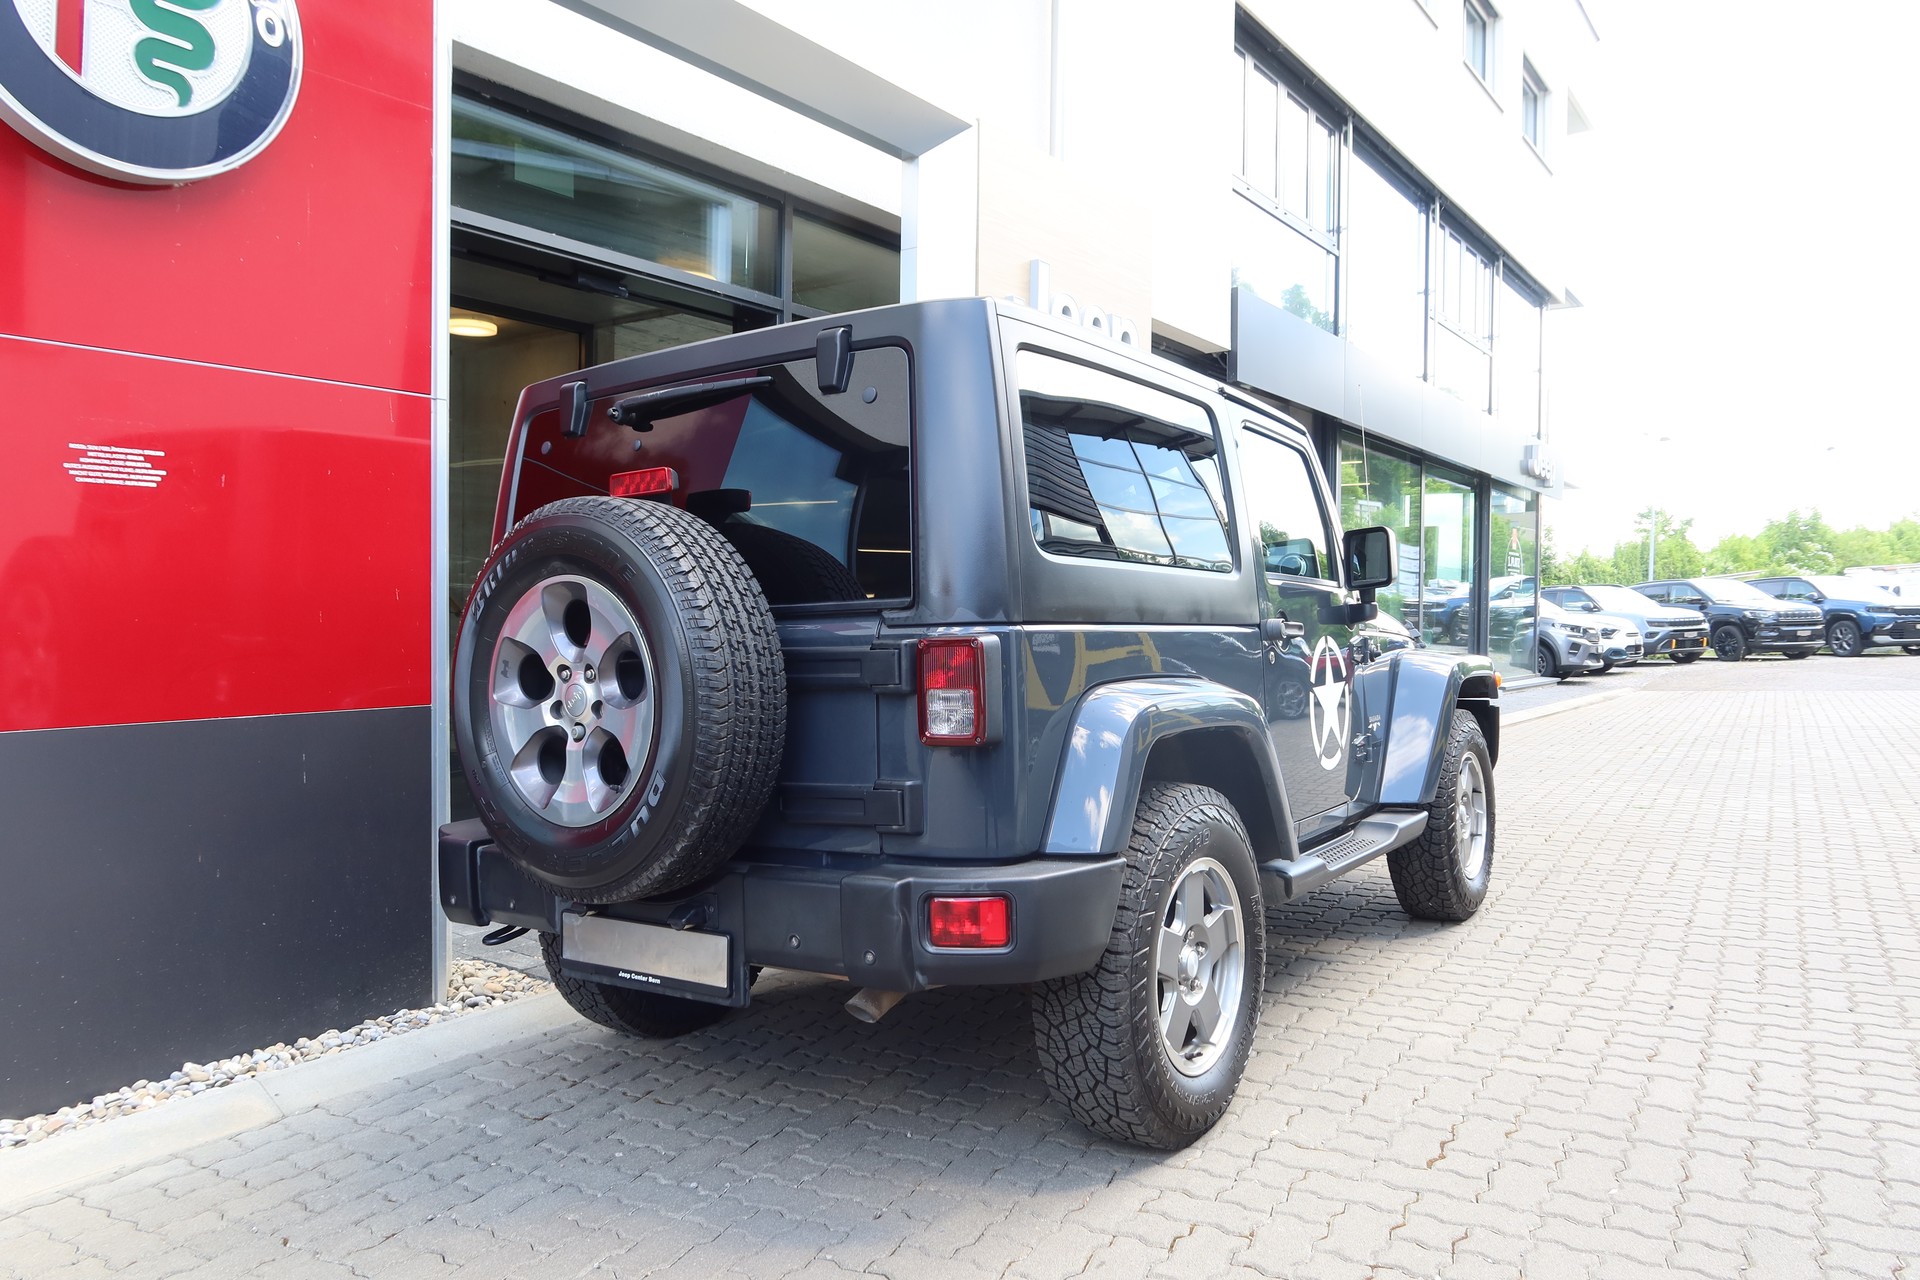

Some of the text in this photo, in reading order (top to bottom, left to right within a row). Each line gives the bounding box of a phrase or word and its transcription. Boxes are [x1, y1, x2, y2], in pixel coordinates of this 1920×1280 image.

[1525, 444, 1556, 488] Jeep
[618, 970, 661, 984] Jeep Center Bern
